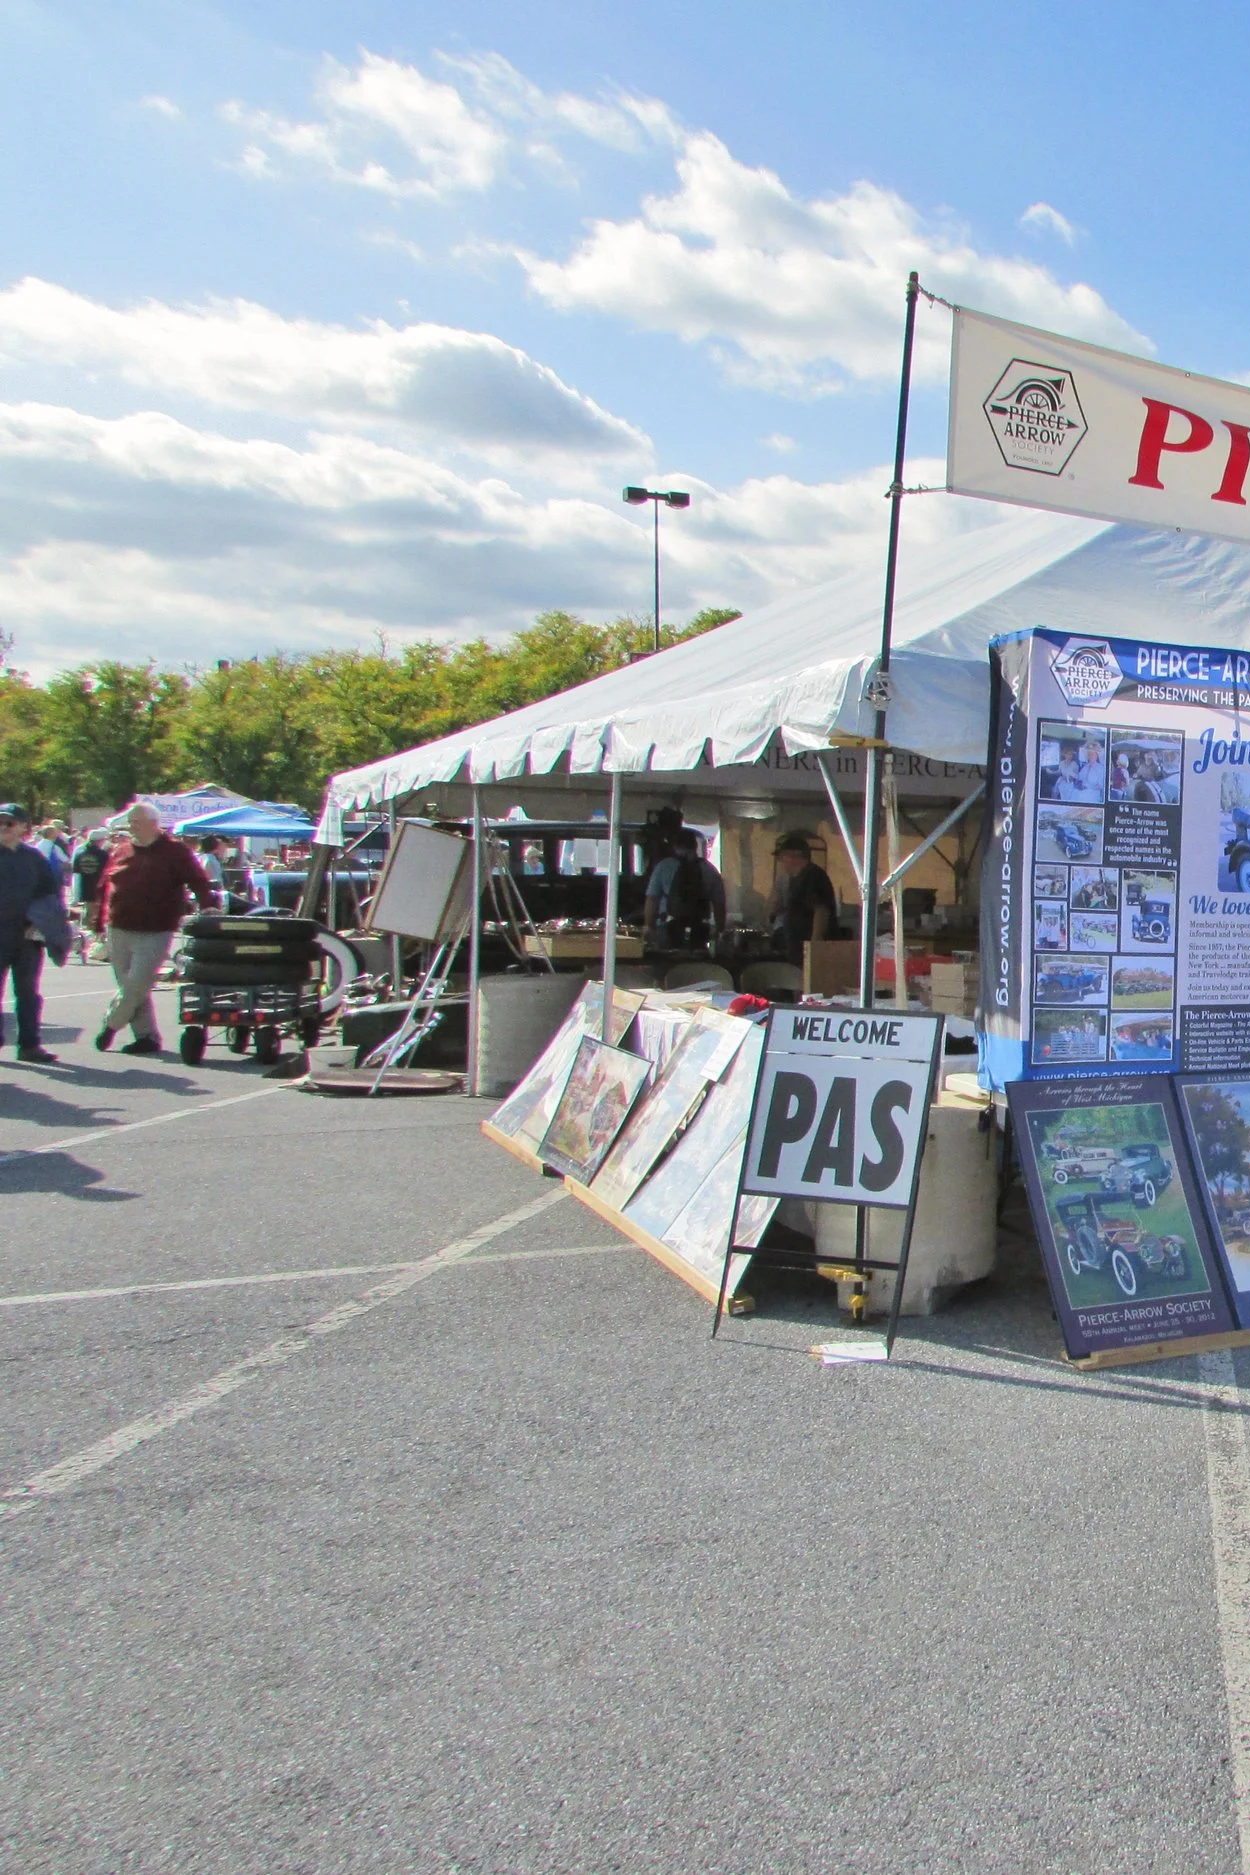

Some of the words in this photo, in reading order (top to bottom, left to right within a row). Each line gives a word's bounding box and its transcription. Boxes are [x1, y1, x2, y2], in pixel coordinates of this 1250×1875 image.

[1009, 405, 1065, 430] PIERCE
[1004, 422, 1065, 446] ARROW
[1012, 440, 1054, 455] SOCIETY
[1067, 666, 1111, 680] PIERCE
[1065, 677, 1110, 690] ARROW
[1070, 688, 1103, 697] SOCIETY
[1137, 685, 1208, 704] PRESERVING
[1213, 690, 1234, 706] THE
[836, 750, 857, 773] in
[1115, 816, 1154, 826] Pierce-Arrow
[1117, 837, 1148, 845] recognized
[1105, 846, 1134, 854] respected
[1143, 856, 1166, 865] industry
[1189, 896, 1218, 914] We
[1190, 921, 1229, 930] Membership
[1202, 970, 1237, 979] Travelodge
[1184, 1010, 1200, 1019] The
[792, 1016, 903, 1046] WELCOME
[757, 1071, 913, 1192] PAS
[1166, 1300, 1212, 1315] SOCIETY
